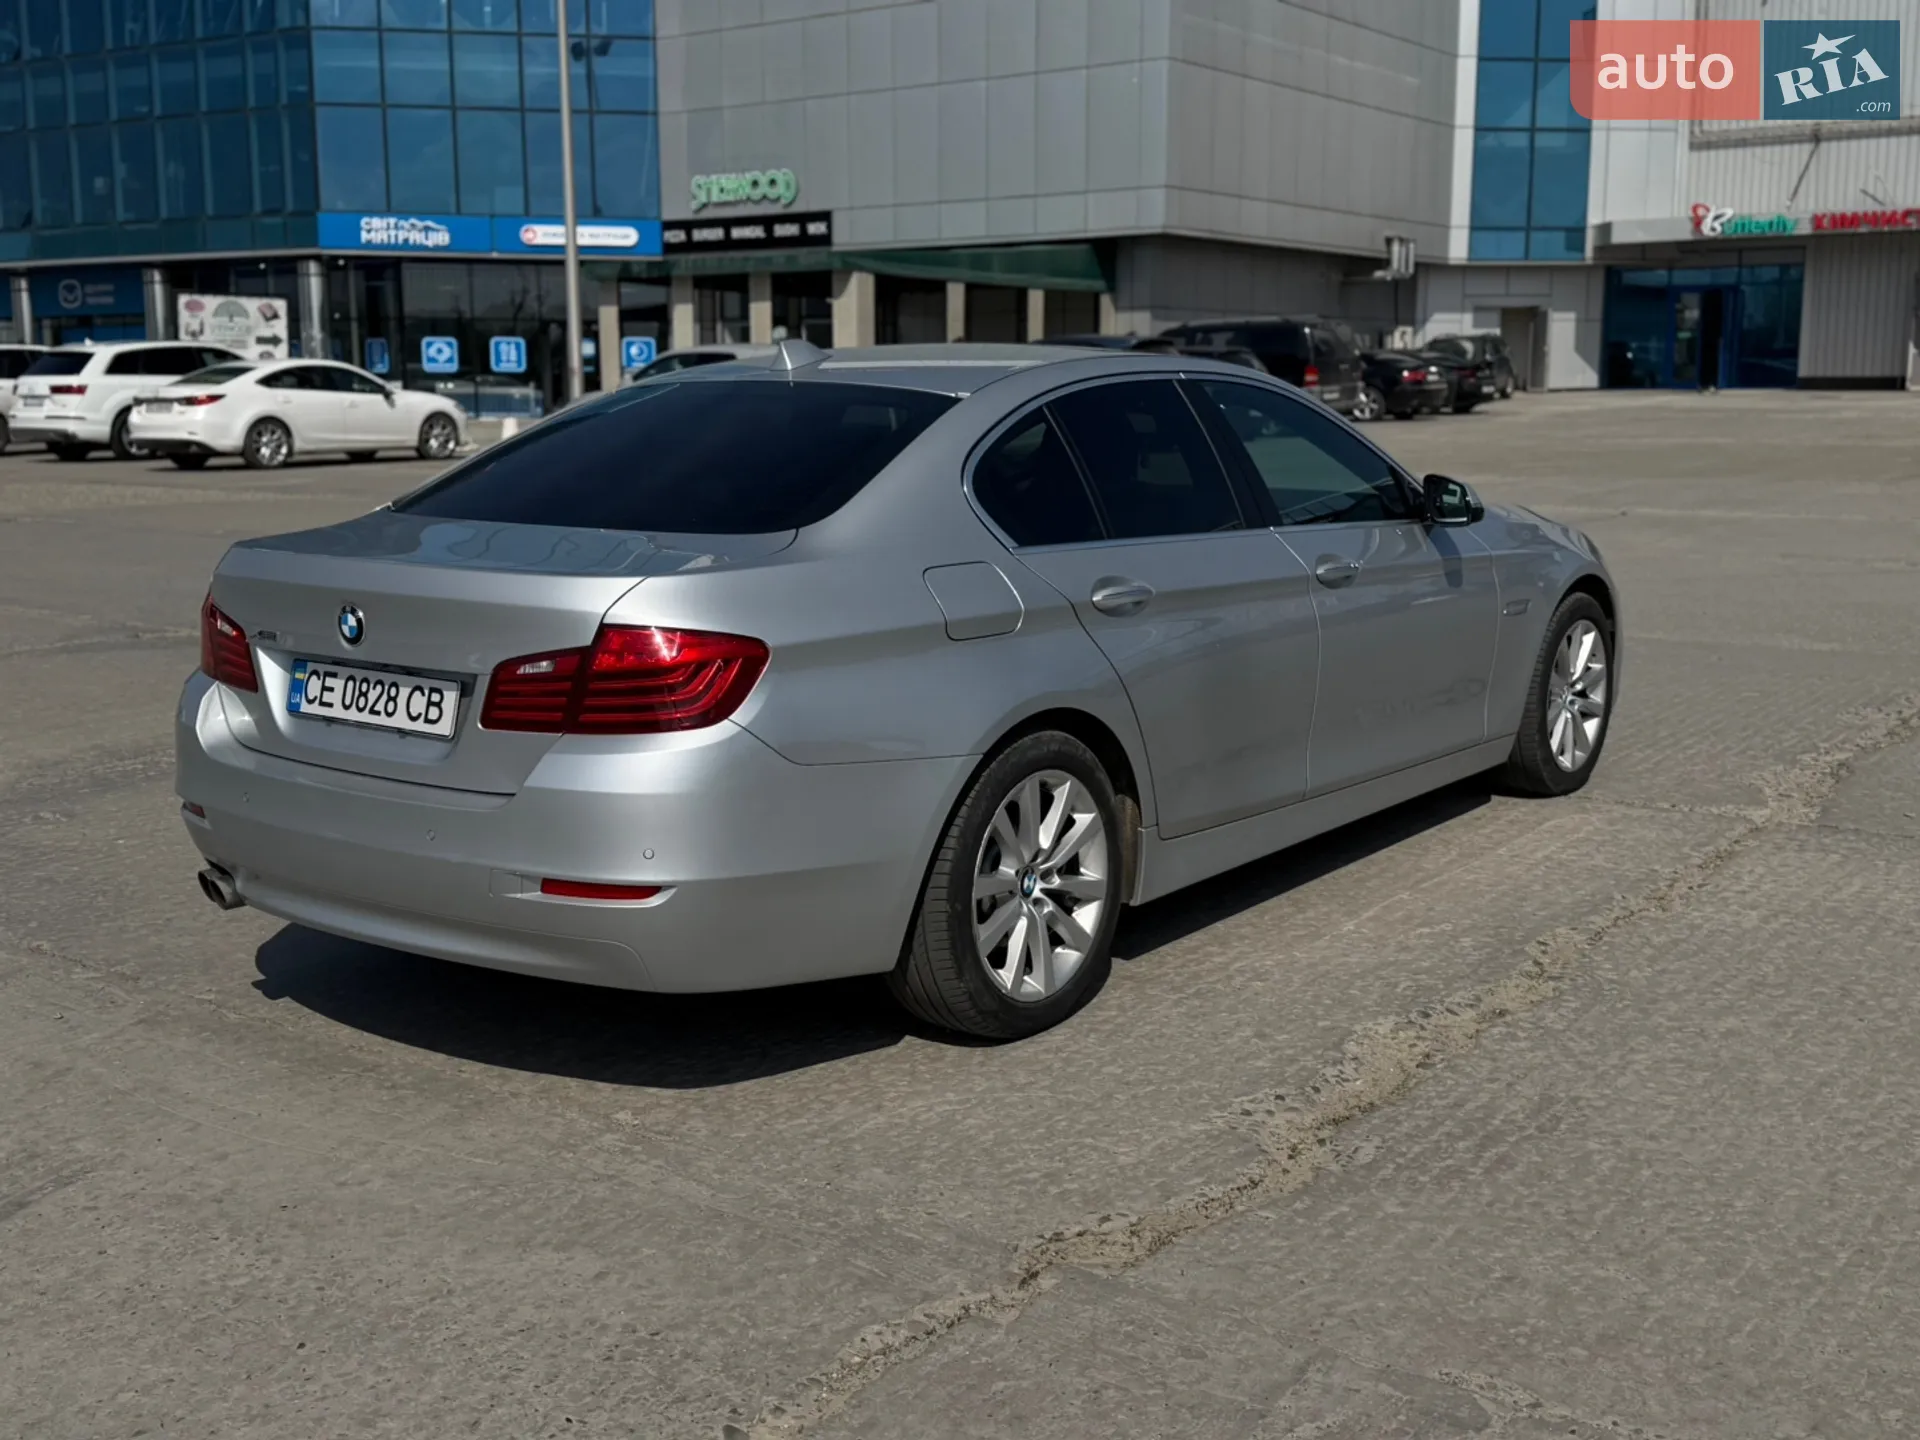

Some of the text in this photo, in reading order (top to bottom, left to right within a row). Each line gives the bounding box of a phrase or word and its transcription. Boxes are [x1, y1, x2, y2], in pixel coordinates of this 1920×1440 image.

[304, 669, 445, 725] CE 0828 CB
